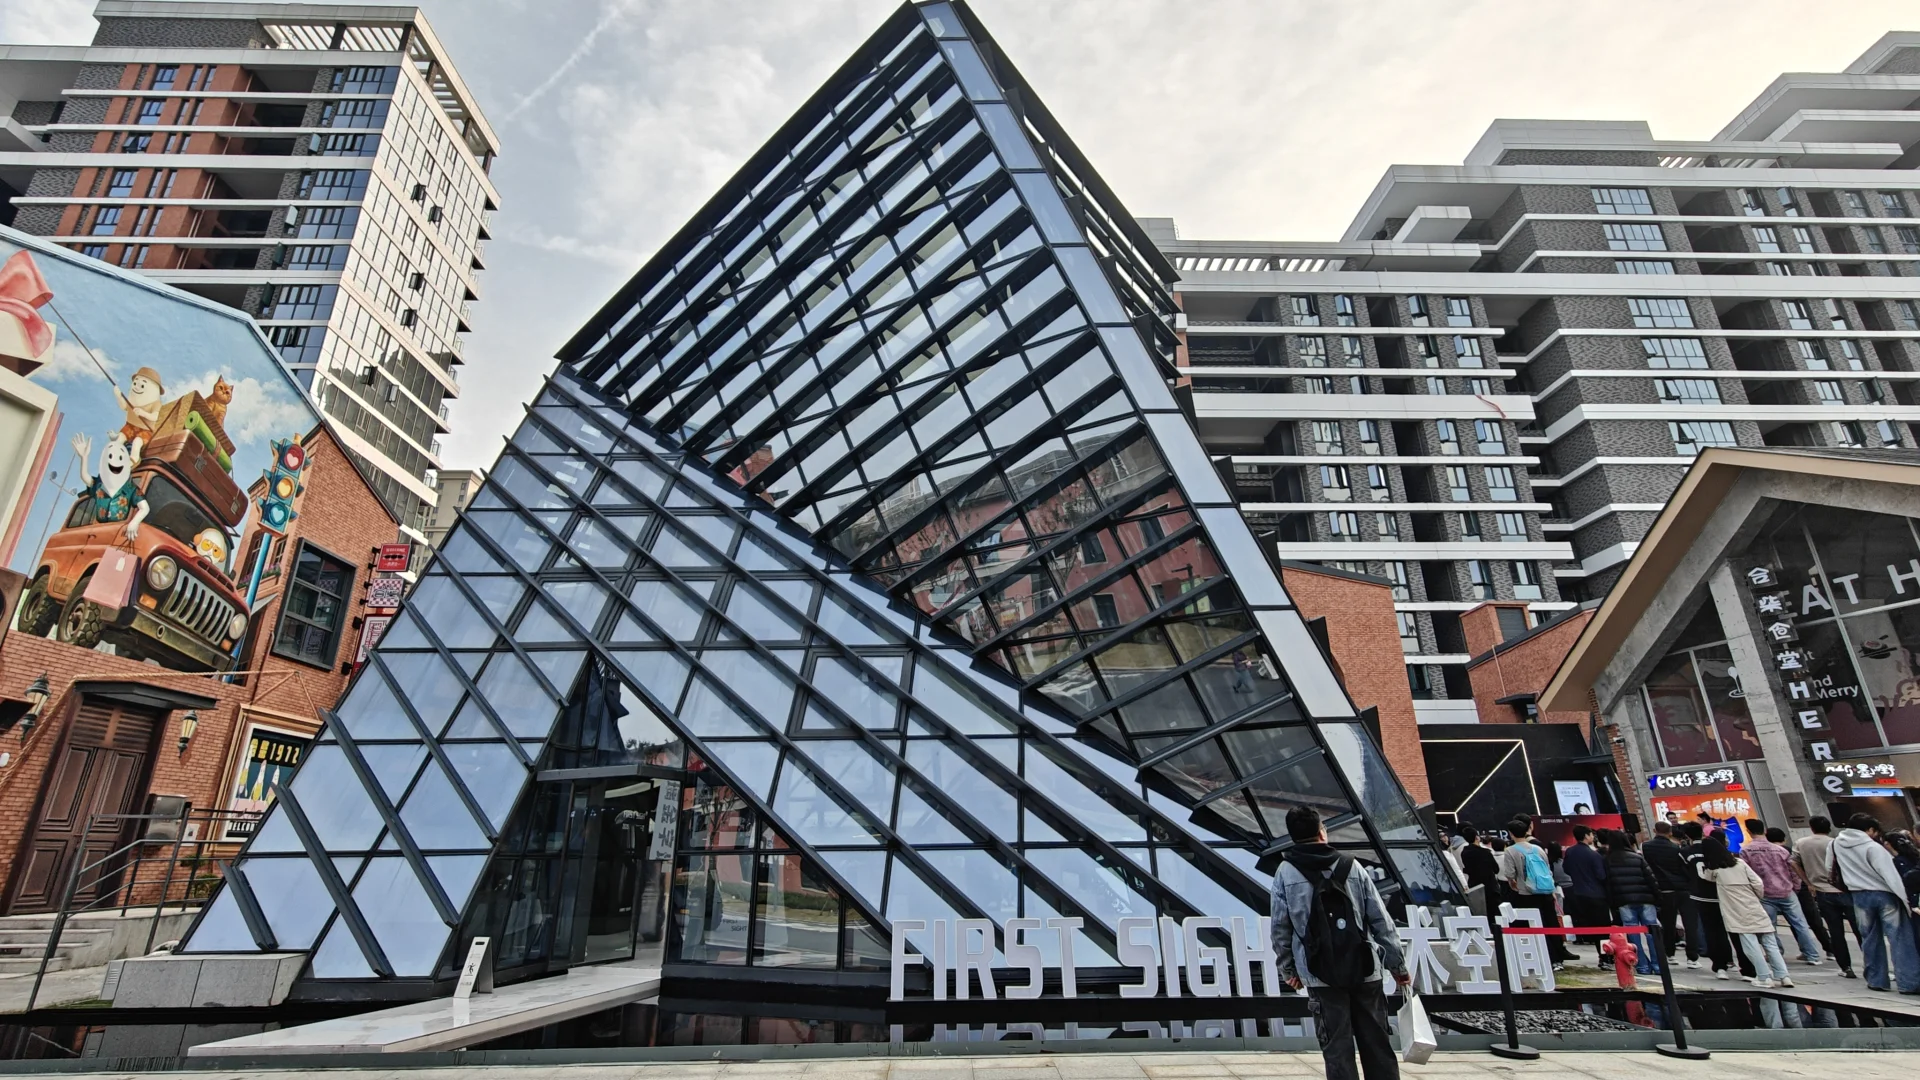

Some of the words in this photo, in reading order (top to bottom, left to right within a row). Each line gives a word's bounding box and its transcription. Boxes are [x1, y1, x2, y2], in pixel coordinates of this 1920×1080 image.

[1779, 573, 1859, 619] AT
[1812, 674, 1833, 688] nd
[890, 916, 1084, 1000] FIRST
[1117, 916, 1308, 998] SIGH
[1383, 902, 1556, 995] 术空间
